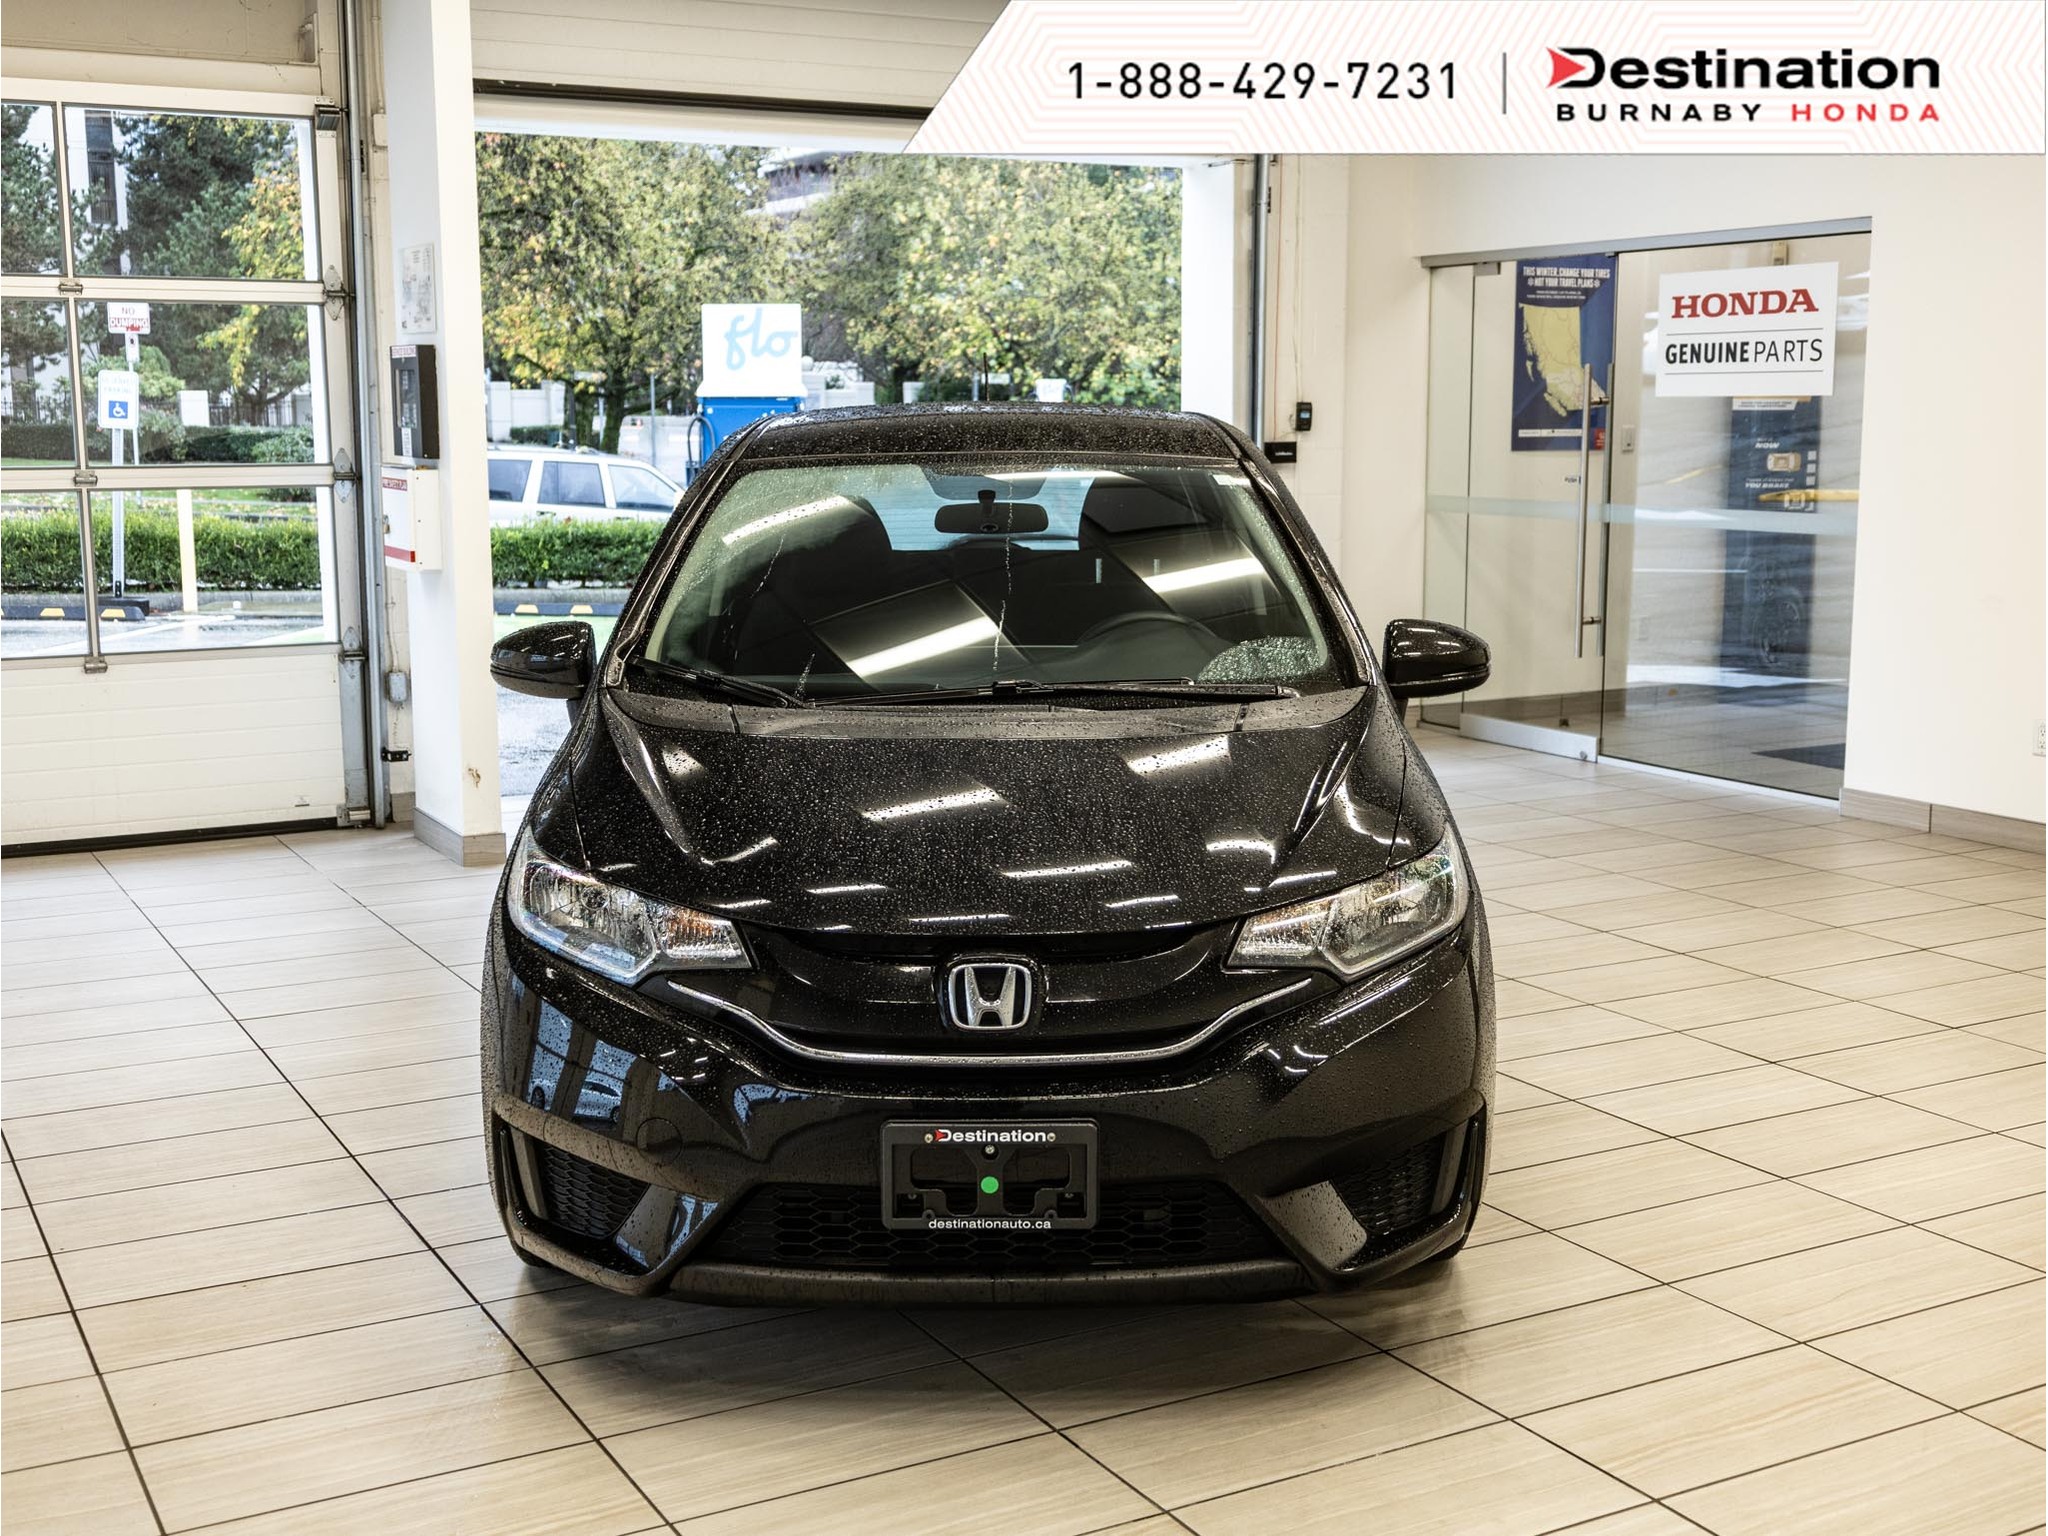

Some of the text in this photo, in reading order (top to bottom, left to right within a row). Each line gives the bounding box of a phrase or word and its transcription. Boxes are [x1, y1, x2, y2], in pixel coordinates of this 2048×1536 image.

[1671, 288, 1819, 318] HONDA
[723, 306, 798, 371] flo
[1665, 338, 1823, 364] GENUINE PARTS
[934, 1129, 1047, 1142] Destination
[928, 1219, 1051, 1229] destinationauto.ca
